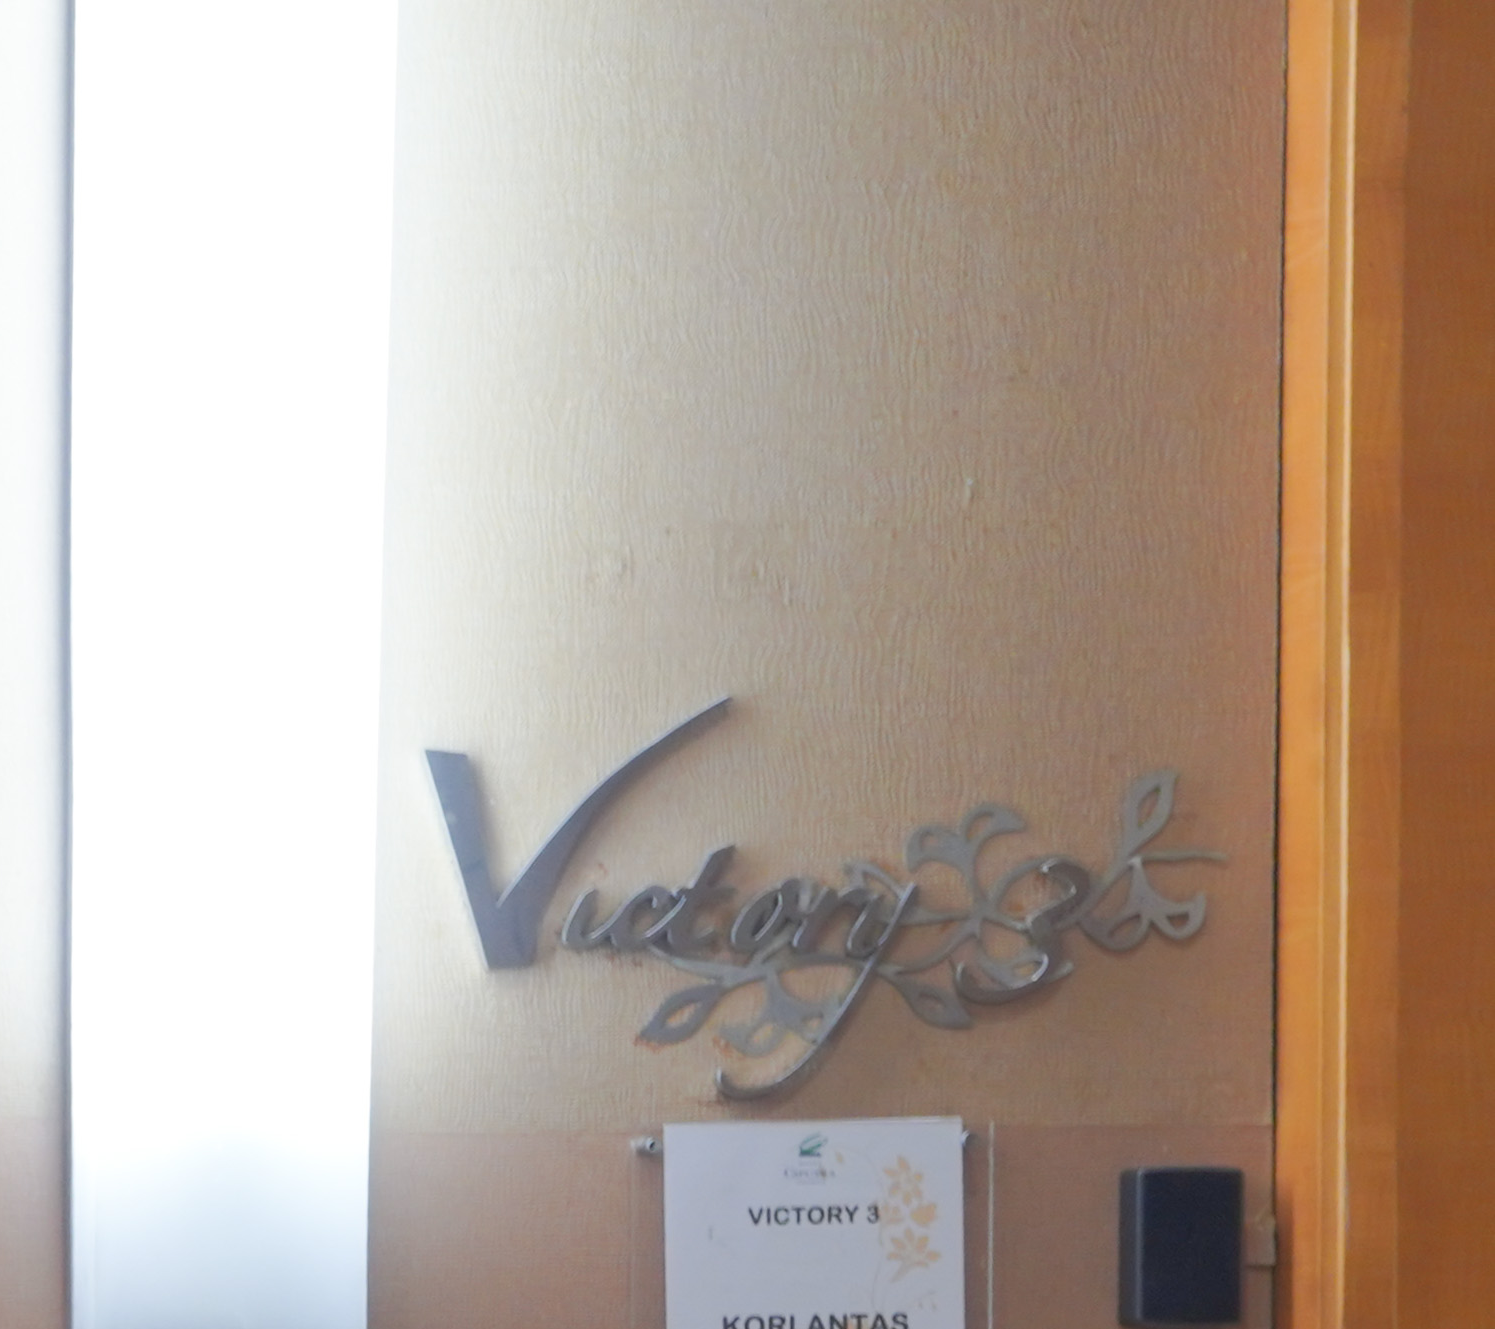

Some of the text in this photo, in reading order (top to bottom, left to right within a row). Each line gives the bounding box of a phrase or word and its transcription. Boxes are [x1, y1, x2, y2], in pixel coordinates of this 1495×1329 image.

[425, 697, 916, 1100] Victory
[748, 1204, 880, 1226] VICTORY 3
